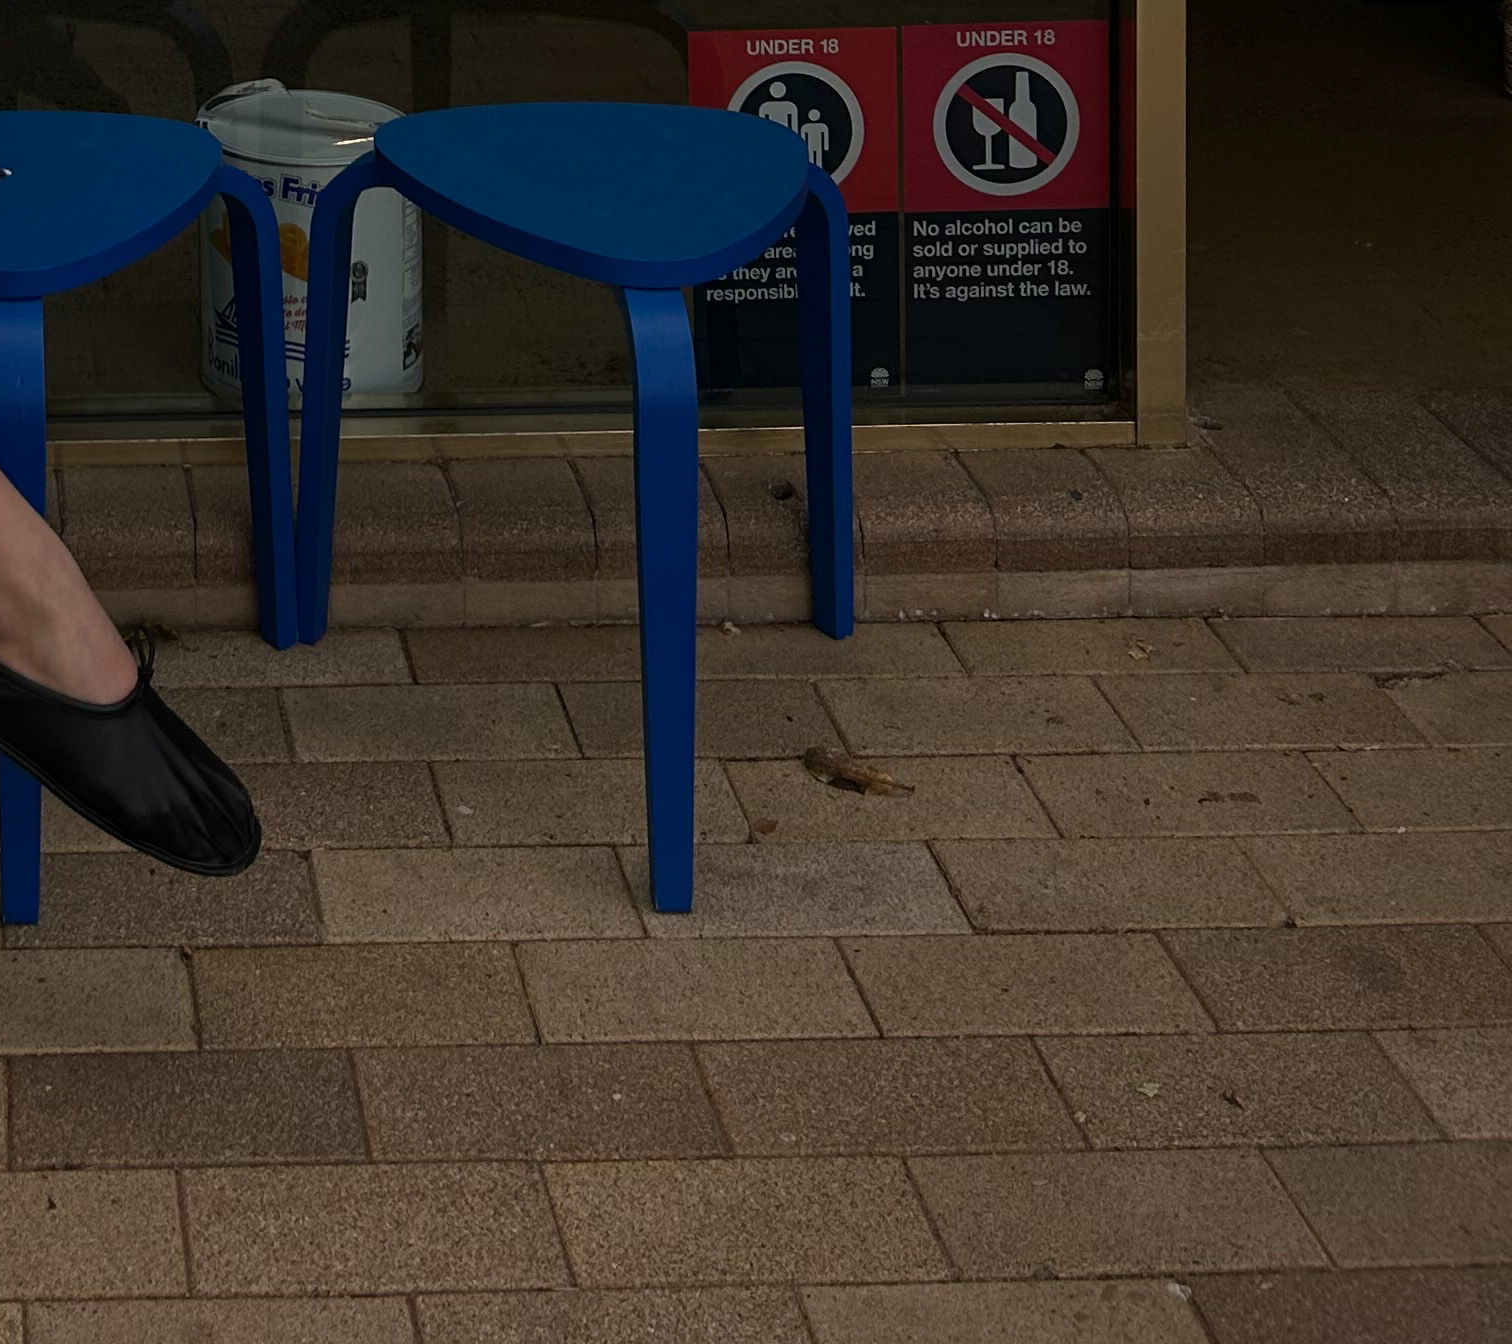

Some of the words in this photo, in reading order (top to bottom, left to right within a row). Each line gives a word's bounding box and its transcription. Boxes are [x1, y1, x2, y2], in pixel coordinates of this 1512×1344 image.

[746, 39, 814, 56] UNDER
[818, 38, 840, 55] 18
[956, 30, 1028, 48] UNDER
[1033, 29, 1056, 46] 18
[912, 220, 940, 237] No
[944, 218, 1014, 236] alcohol
[1018, 220, 1053, 235] can
[1058, 217, 1083, 233] be
[912, 241, 953, 258] sold
[957, 243, 979, 256] or
[983, 238, 1064, 259] supplied
[1068, 239, 1088, 255] to
[852, 264, 864, 277] a
[912, 263, 982, 281] anyone
[987, 261, 1042, 277] under
[1047, 259, 1075, 275] 18.
[706, 283, 799, 304] responsibl
[912, 282, 940, 299] It's
[944, 282, 1015, 302] against
[1018, 281, 1050, 297] the
[1054, 281, 1092, 297] law.
